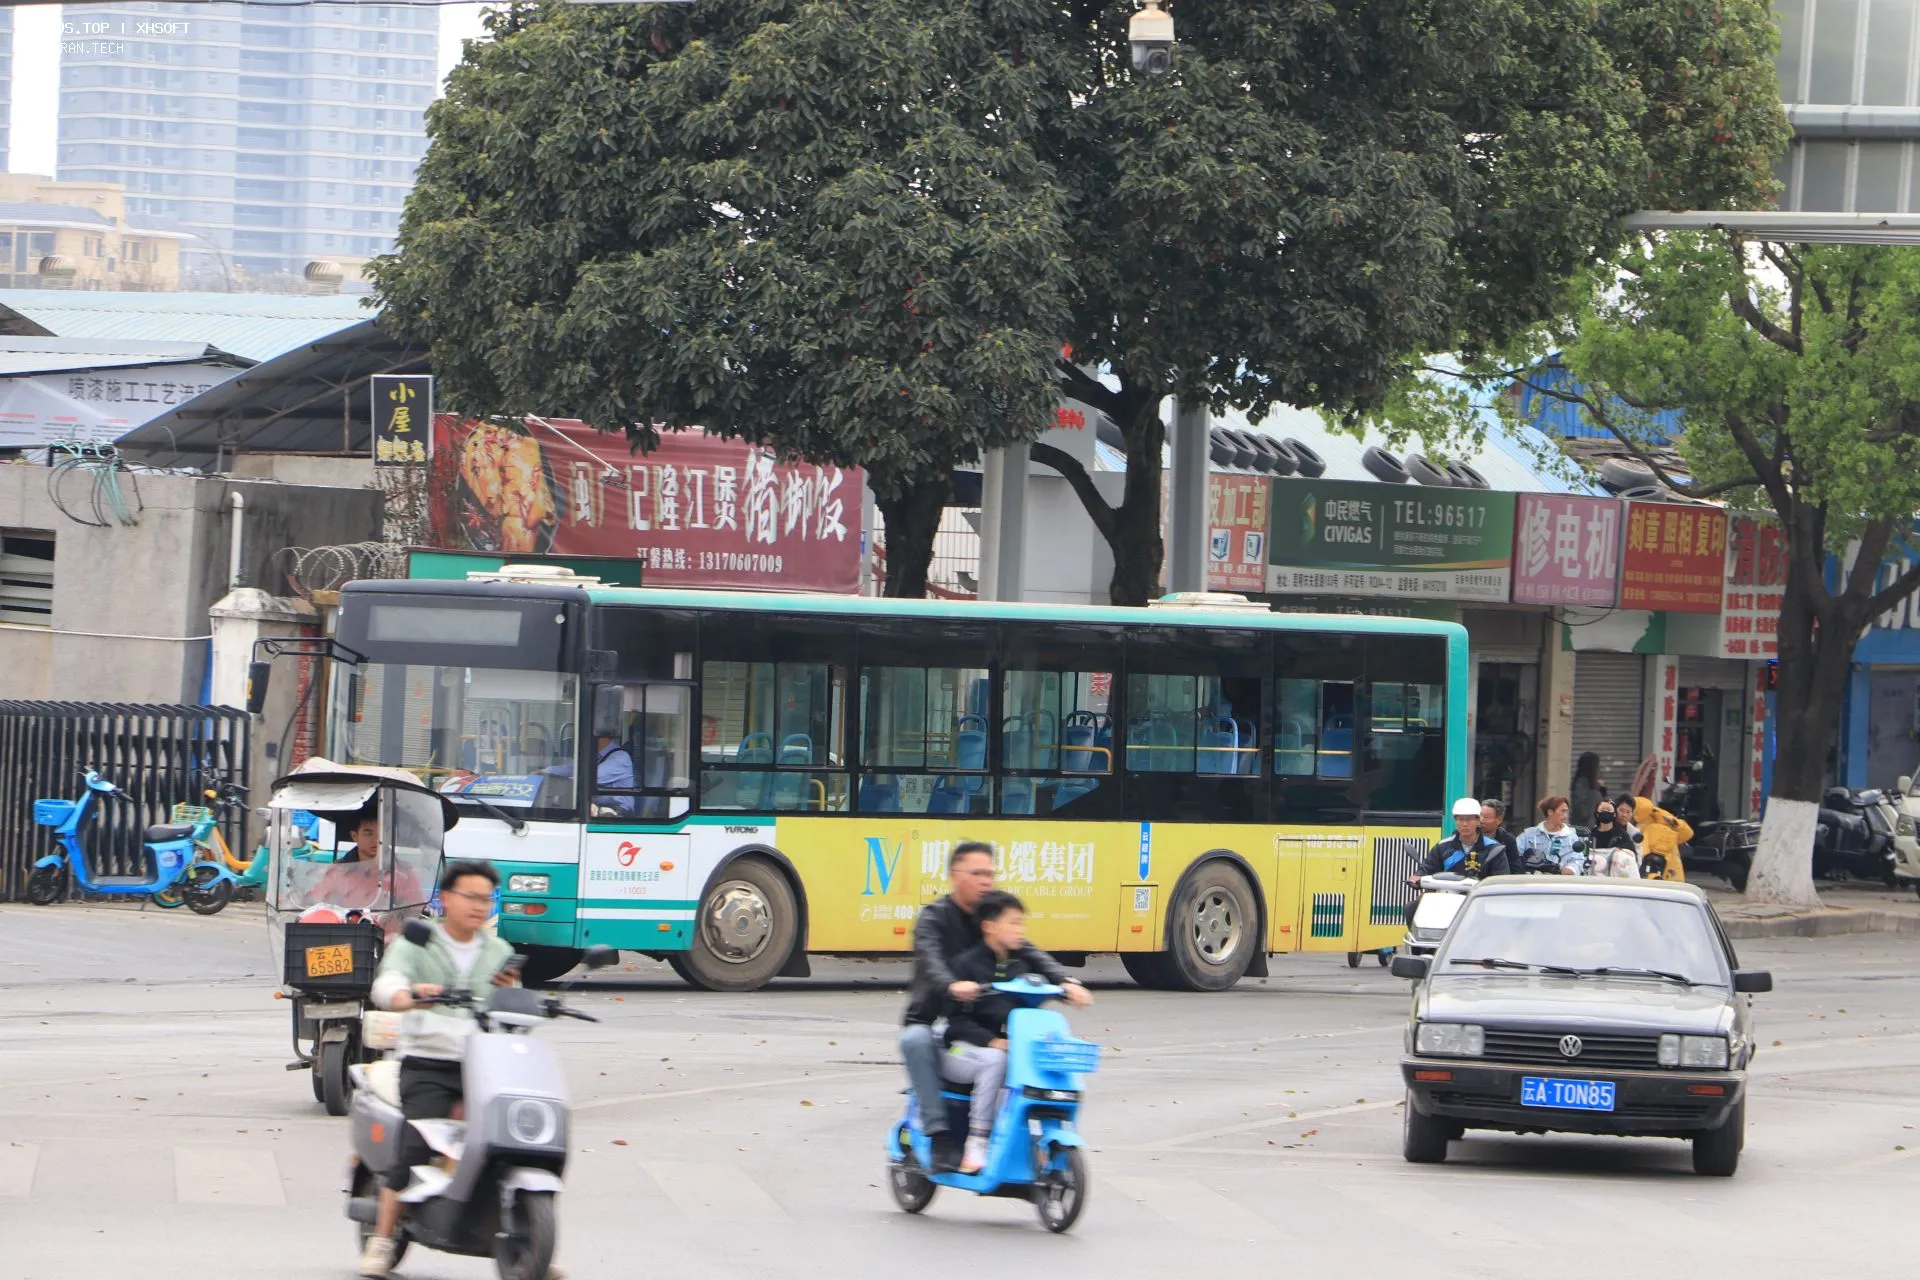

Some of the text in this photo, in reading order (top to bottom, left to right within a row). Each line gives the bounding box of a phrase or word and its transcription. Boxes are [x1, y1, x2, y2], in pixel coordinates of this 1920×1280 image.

[387, 382, 416, 433] 小屋
[1324, 499, 1373, 522] 中民燃气
[1394, 500, 1487, 529] TEL:96517
[1323, 525, 1373, 544] CIVIGAS
[1519, 499, 1615, 580] 修电机
[698, 551, 784, 573] 13170607009
[724, 825, 759, 834] YUTONG
[1025, 885, 1057, 897] CABLE
[1059, 885, 1093, 897] GROUP
[311, 958, 351, 975] 65S82
